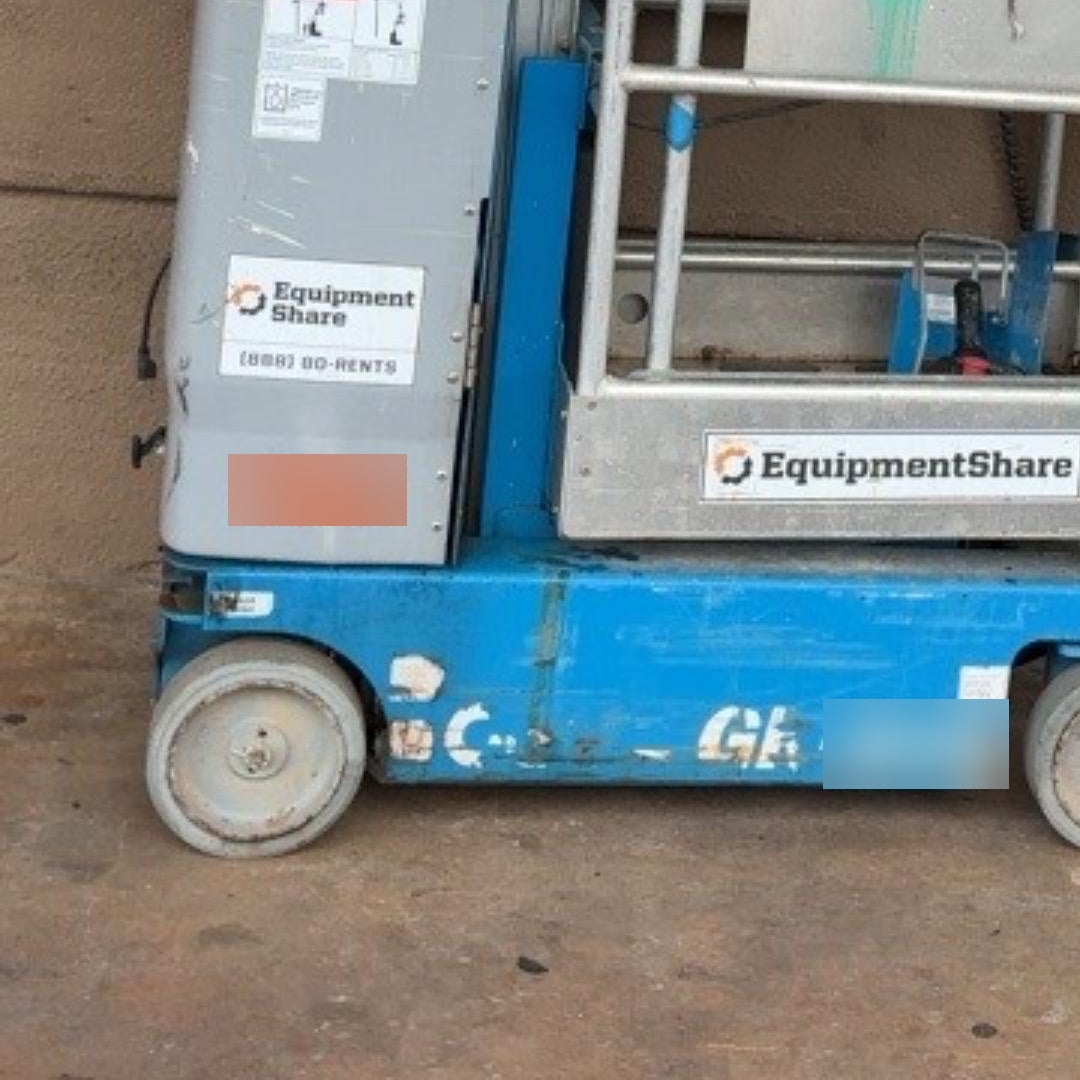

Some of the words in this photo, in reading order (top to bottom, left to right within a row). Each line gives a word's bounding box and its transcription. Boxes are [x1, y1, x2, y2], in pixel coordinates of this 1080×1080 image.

[273, 281, 415, 308] Equipment
[272, 304, 347, 327] Share
[761, 450, 1074, 485] EquipmentShare
